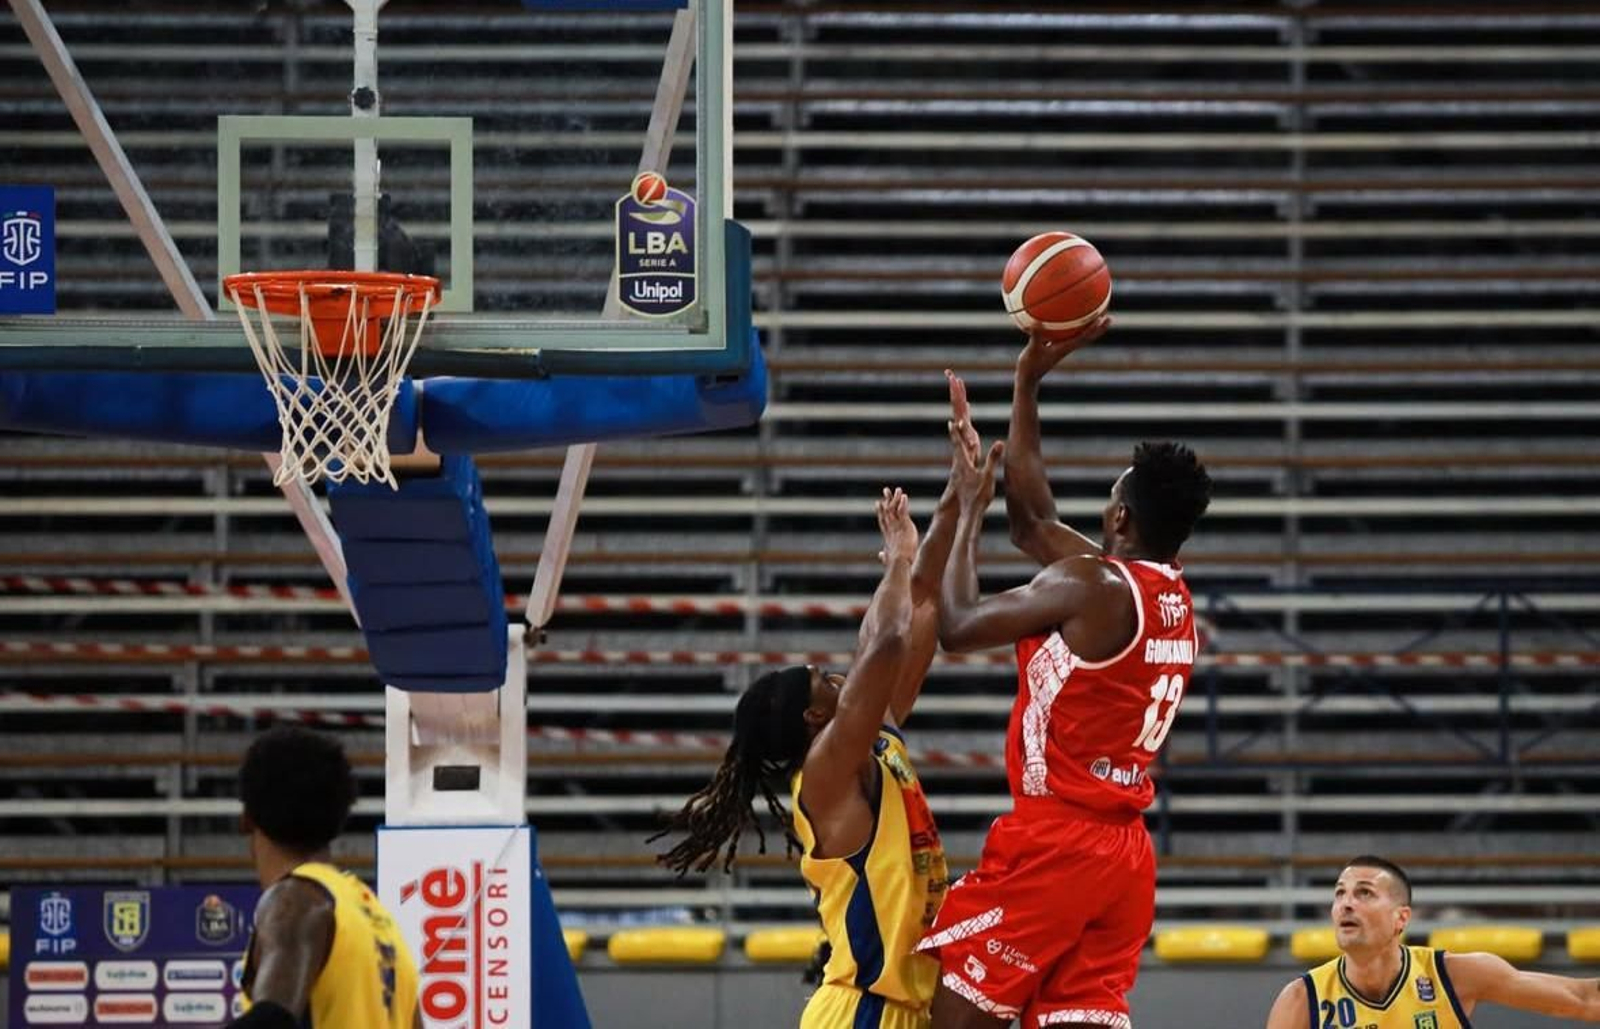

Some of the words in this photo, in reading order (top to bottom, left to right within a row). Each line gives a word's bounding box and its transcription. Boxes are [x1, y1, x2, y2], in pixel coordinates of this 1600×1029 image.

[628, 231, 688, 255] LBA
[638, 258, 667, 267] SERIE
[670, 259, 677, 267] A
[0, 272, 48, 290] FIP
[634, 280, 683, 304] Unipol
[1132, 673, 1184, 752] 13
[35, 938, 77, 955] FIP
[400, 866, 467, 1029] omè
[1321, 998, 1357, 1029] 20
